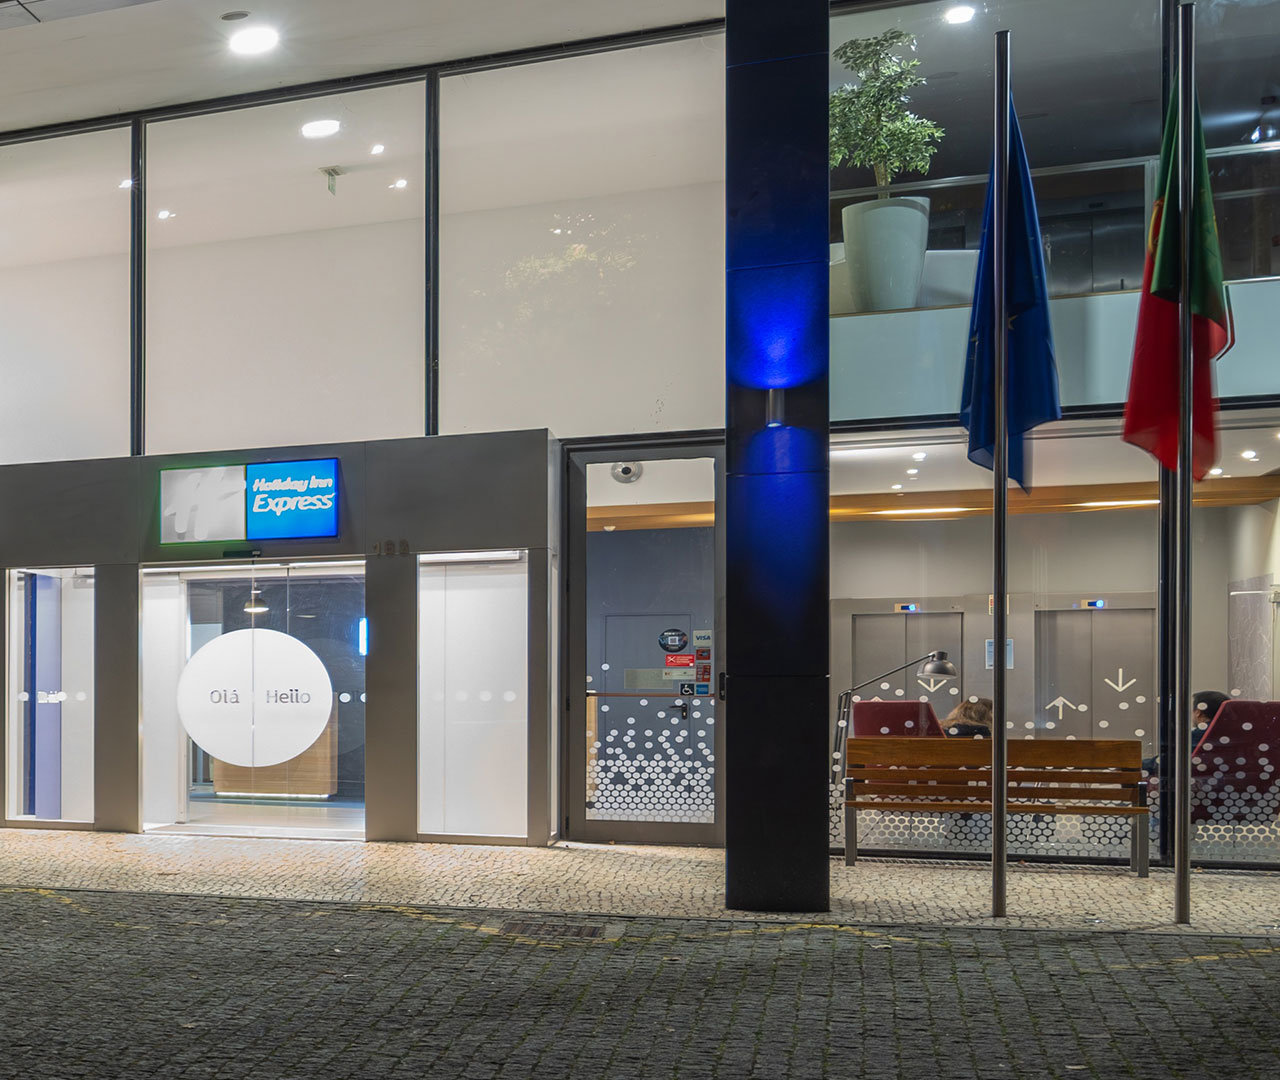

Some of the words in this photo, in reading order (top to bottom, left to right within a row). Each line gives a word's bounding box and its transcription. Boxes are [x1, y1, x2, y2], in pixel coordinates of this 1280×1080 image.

[252, 477, 309, 492] Holiday
[309, 475, 333, 488] Inn
[252, 493, 336, 516] Express
[209, 689, 240, 704] Olá
[266, 688, 312, 704] Hello
